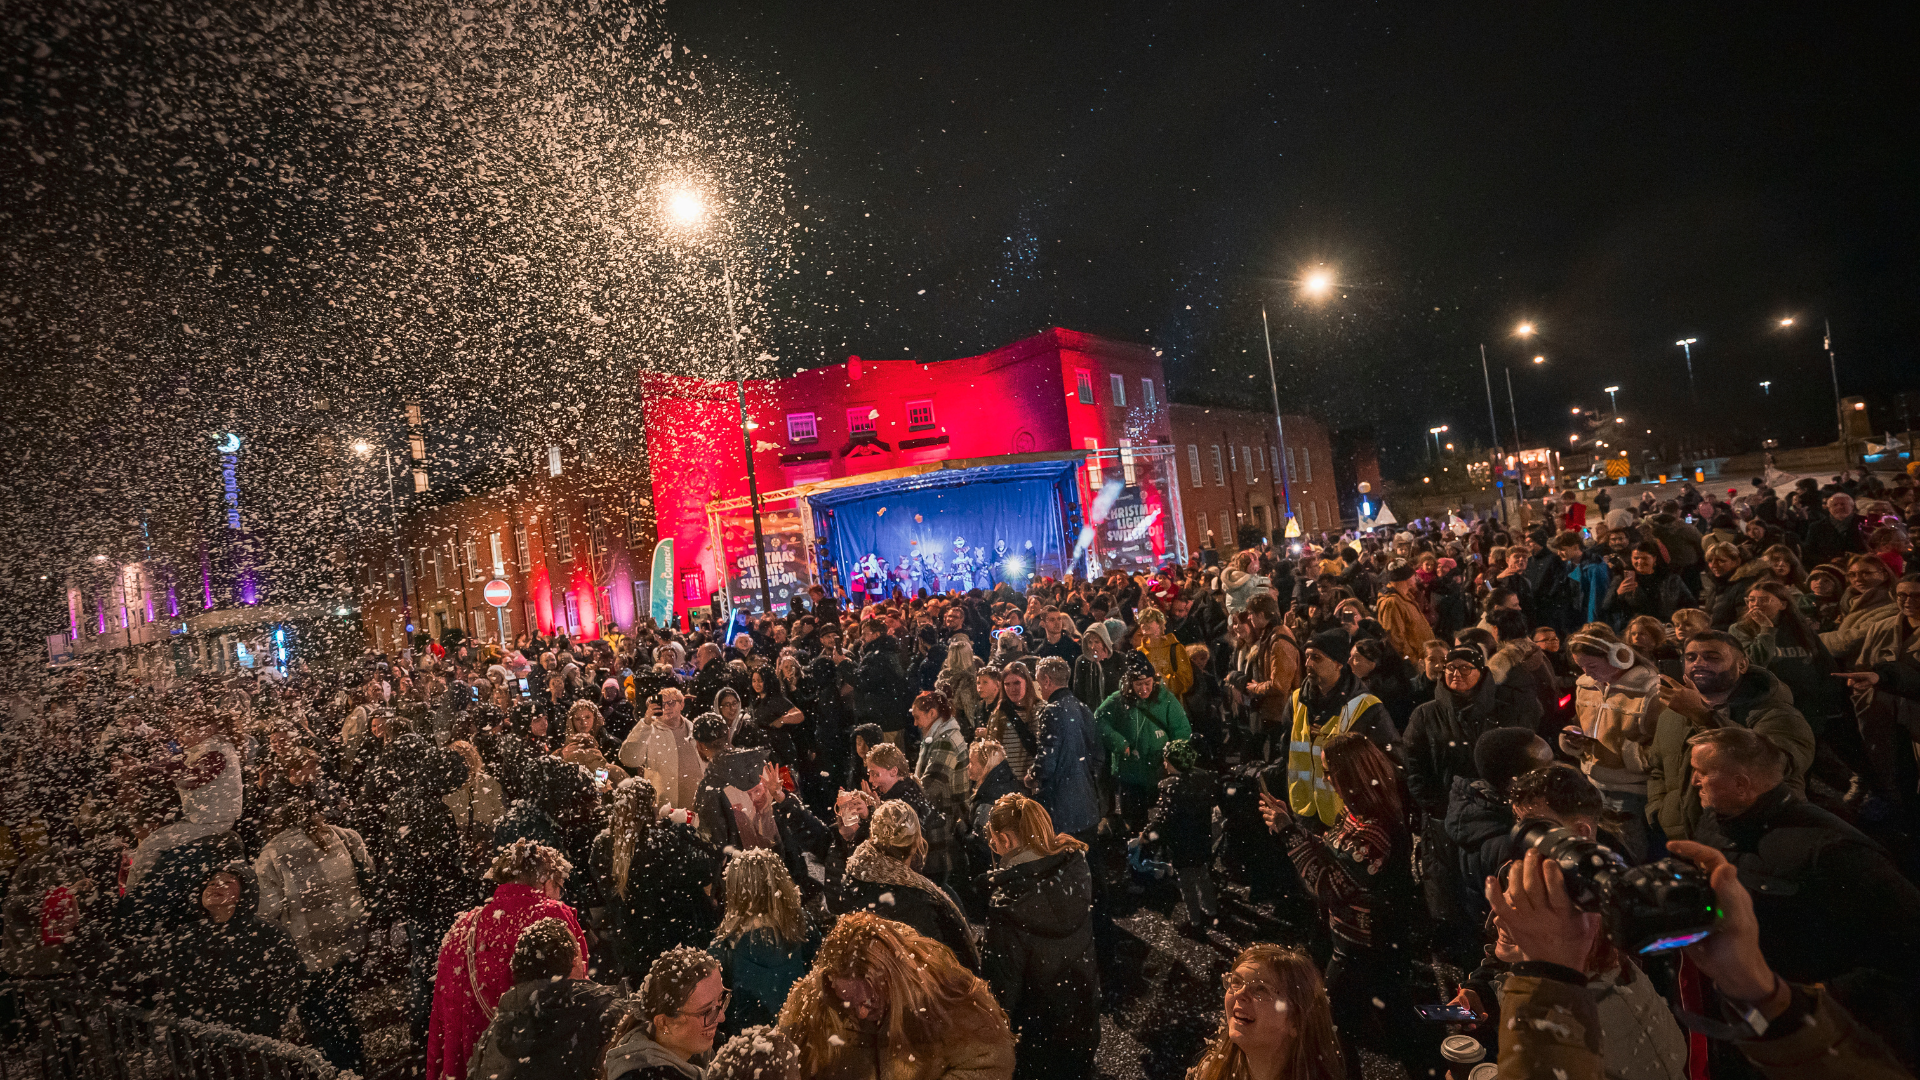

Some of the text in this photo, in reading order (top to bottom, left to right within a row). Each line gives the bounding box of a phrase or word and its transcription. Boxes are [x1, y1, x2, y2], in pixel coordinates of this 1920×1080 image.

[1106, 503, 1161, 520] HRISTMA
[1117, 515, 1149, 530] LIGH
[737, 551, 796, 569] CHRITMAS
[750, 562, 785, 577] LIHTS
[661, 545, 673, 622] erby City Council
[740, 571, 797, 590] SWICH-ON
